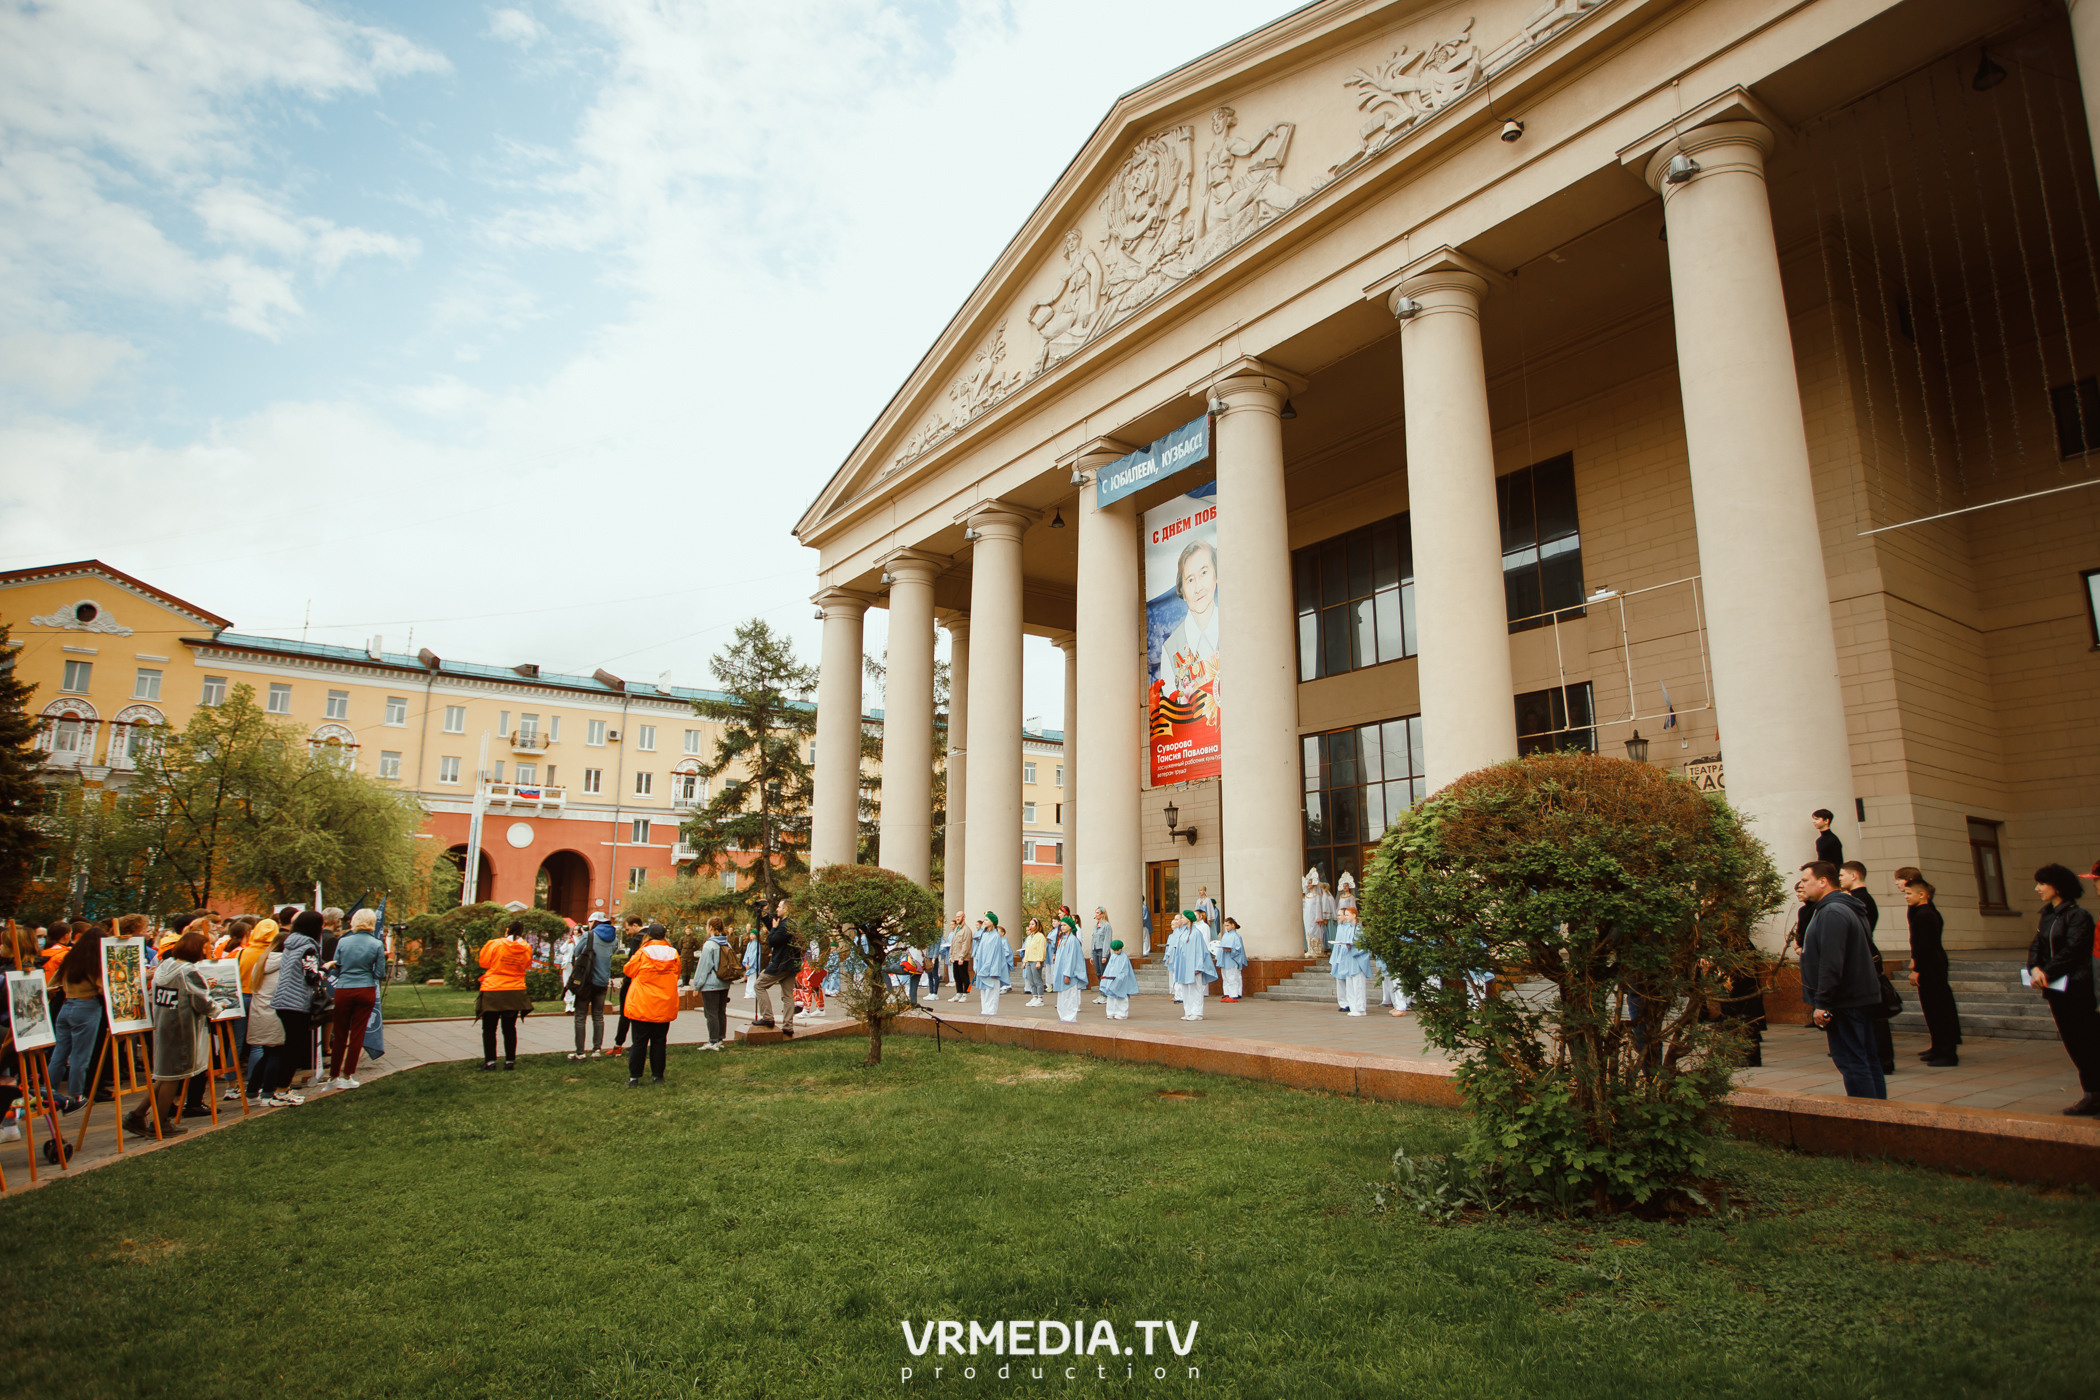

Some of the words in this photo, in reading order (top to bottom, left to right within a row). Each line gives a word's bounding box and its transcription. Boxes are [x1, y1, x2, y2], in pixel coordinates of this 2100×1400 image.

[1101, 480, 1108, 494] С
[1110, 458, 1159, 492] ЮБИЛЕЕМ,
[1161, 432, 1203, 468] КУЗБАСС!
[1152, 530, 1159, 544] С
[1162, 516, 1191, 543] ДНЁМ
[1156, 739, 1193, 754] Суворова
[1156, 752, 1182, 764] Таисия
[1182, 744, 1219, 759] Павловна
